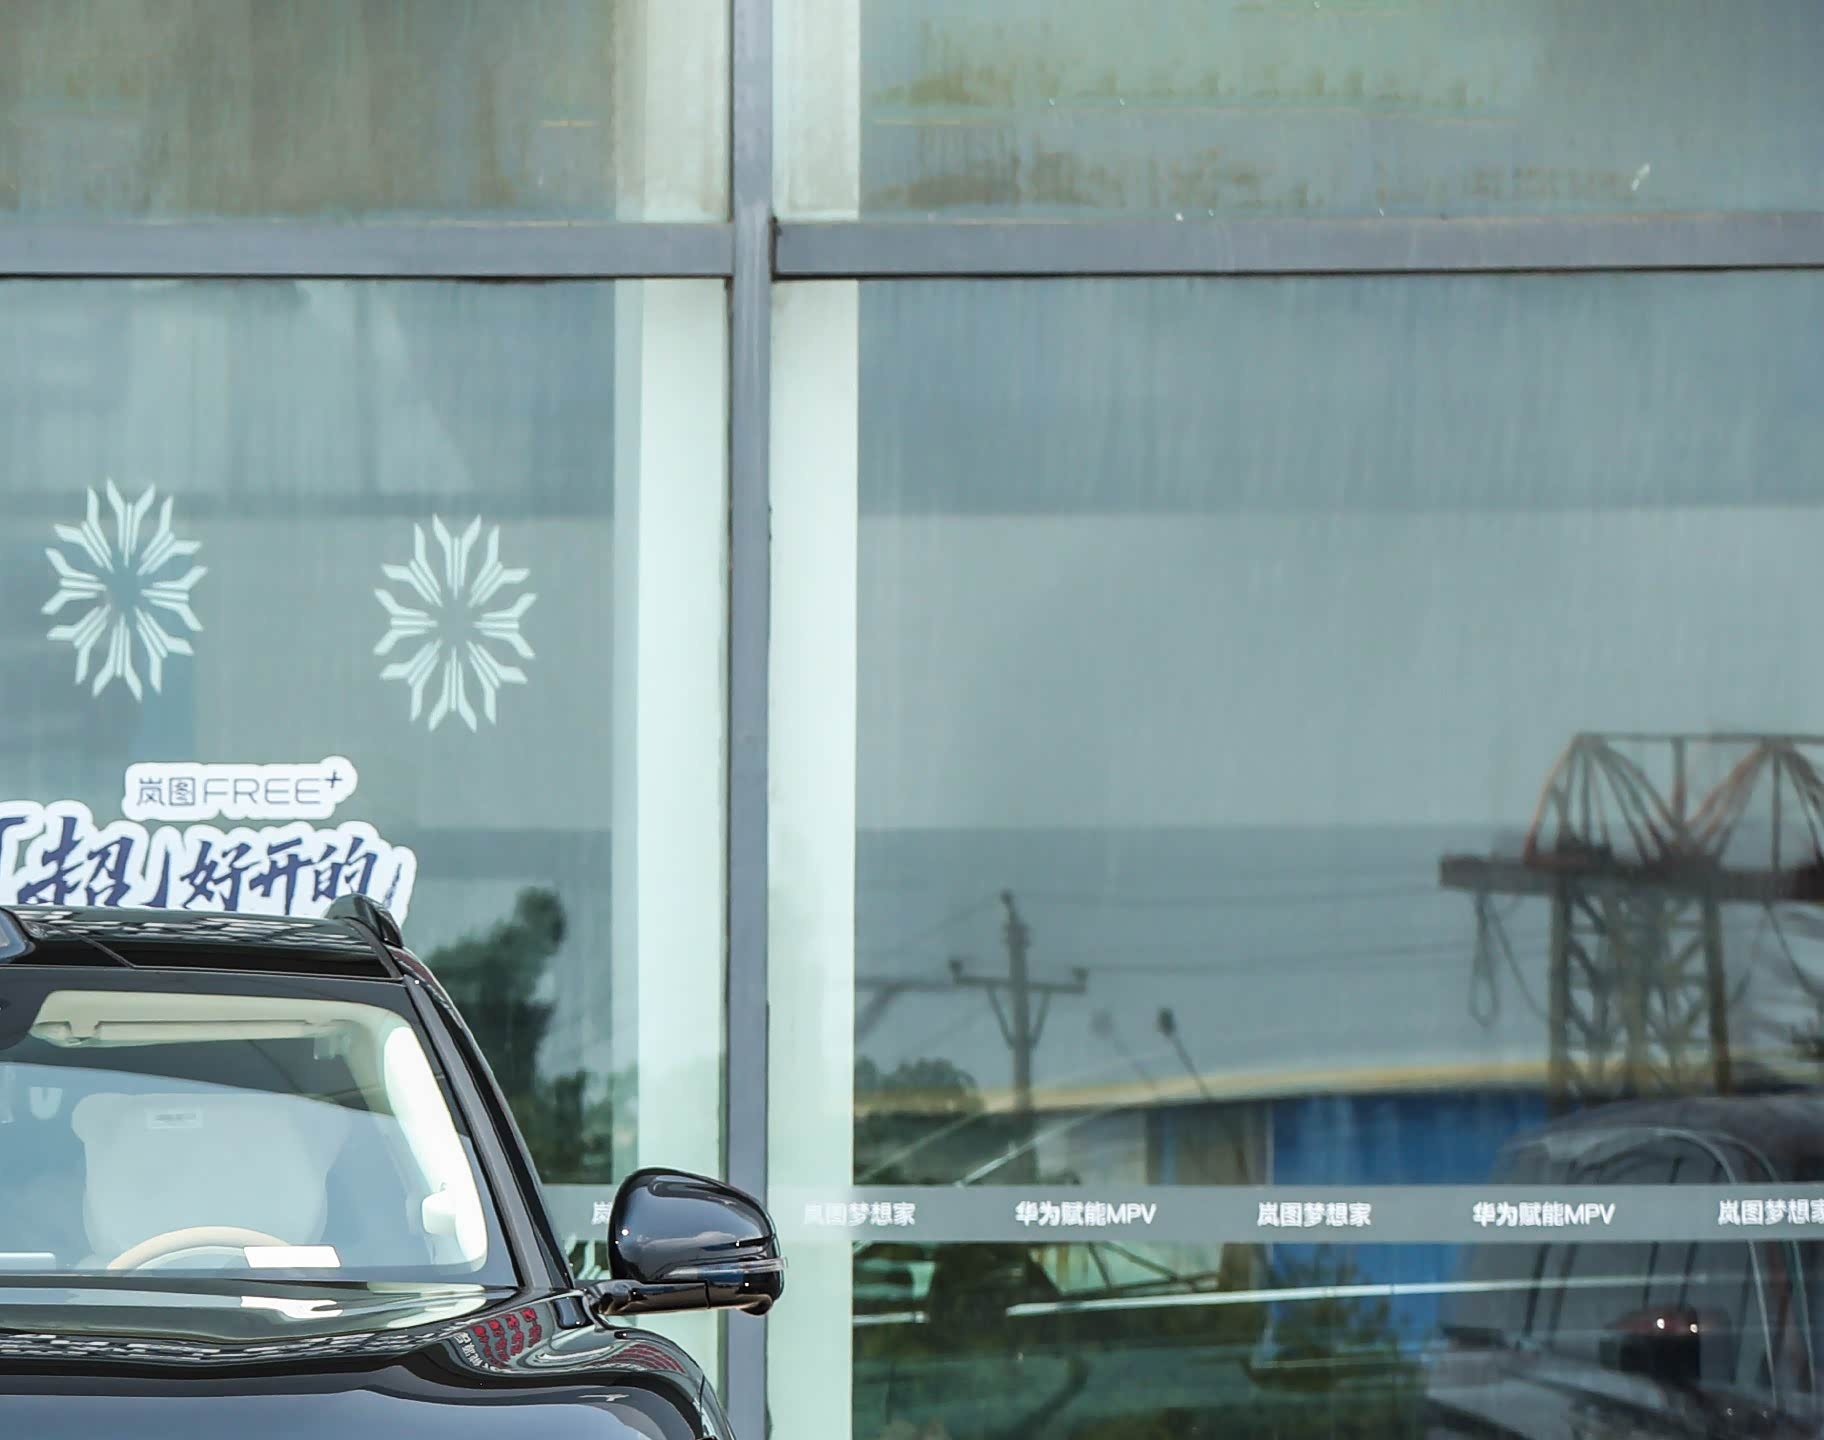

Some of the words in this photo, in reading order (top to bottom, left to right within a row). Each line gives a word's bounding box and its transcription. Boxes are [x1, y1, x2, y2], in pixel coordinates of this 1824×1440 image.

[803, 1201, 916, 1227] 岚图梦想家
[1014, 1200, 1157, 1226] 华为赋能MPV
[1257, 1201, 1372, 1227] 岚图梦想家
[1473, 1201, 1616, 1226] 华为赋能MPV
